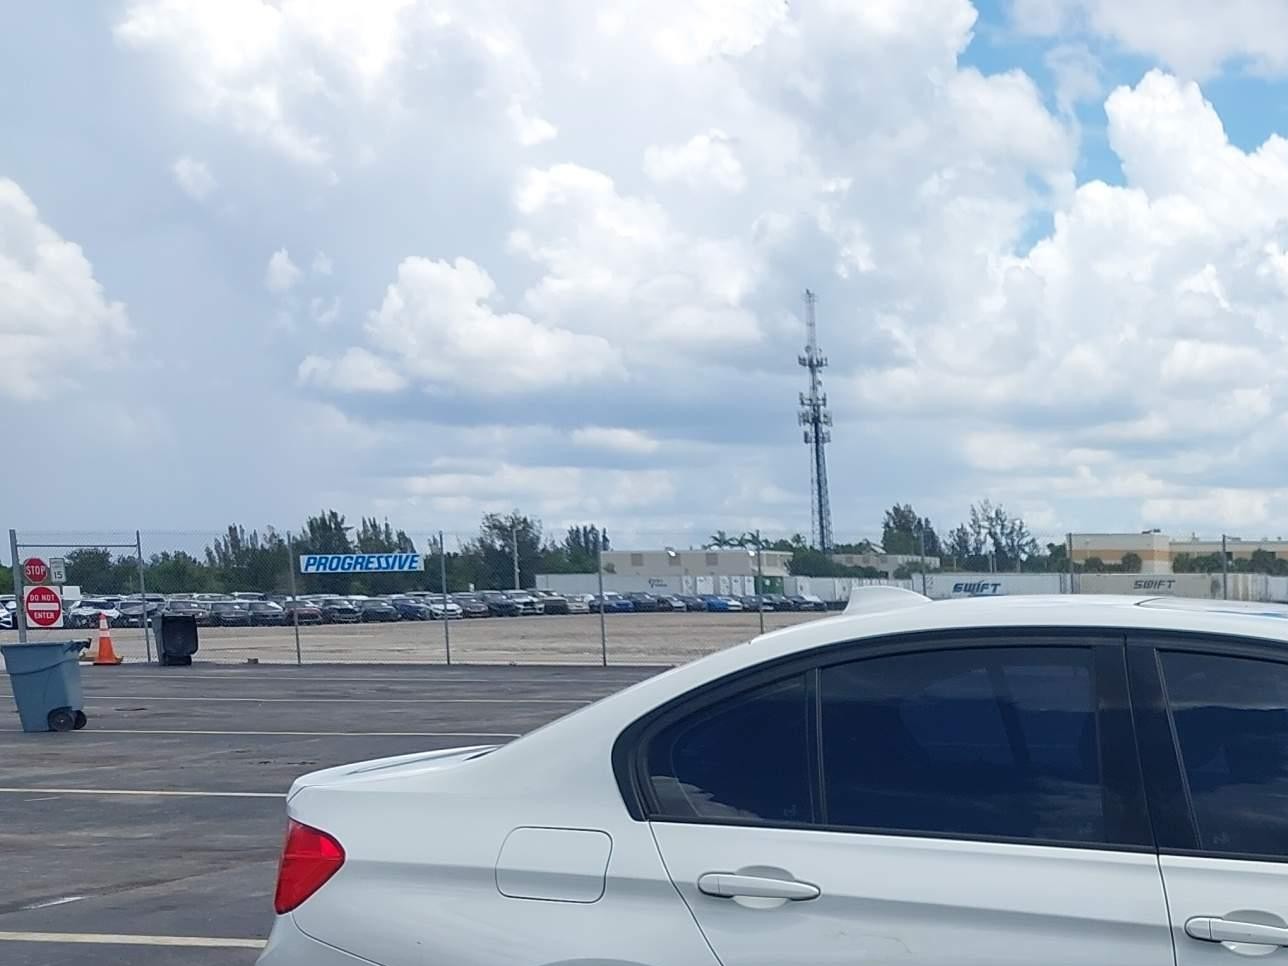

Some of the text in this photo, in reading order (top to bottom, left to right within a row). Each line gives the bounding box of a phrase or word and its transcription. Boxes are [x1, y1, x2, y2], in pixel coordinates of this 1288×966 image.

[304, 555, 420, 571] PROGRESSIVE
[26, 565, 46, 575] STOP
[54, 571, 63, 579] 15
[952, 580, 1002, 593] SWIFT
[1133, 579, 1177, 590] SWIFT
